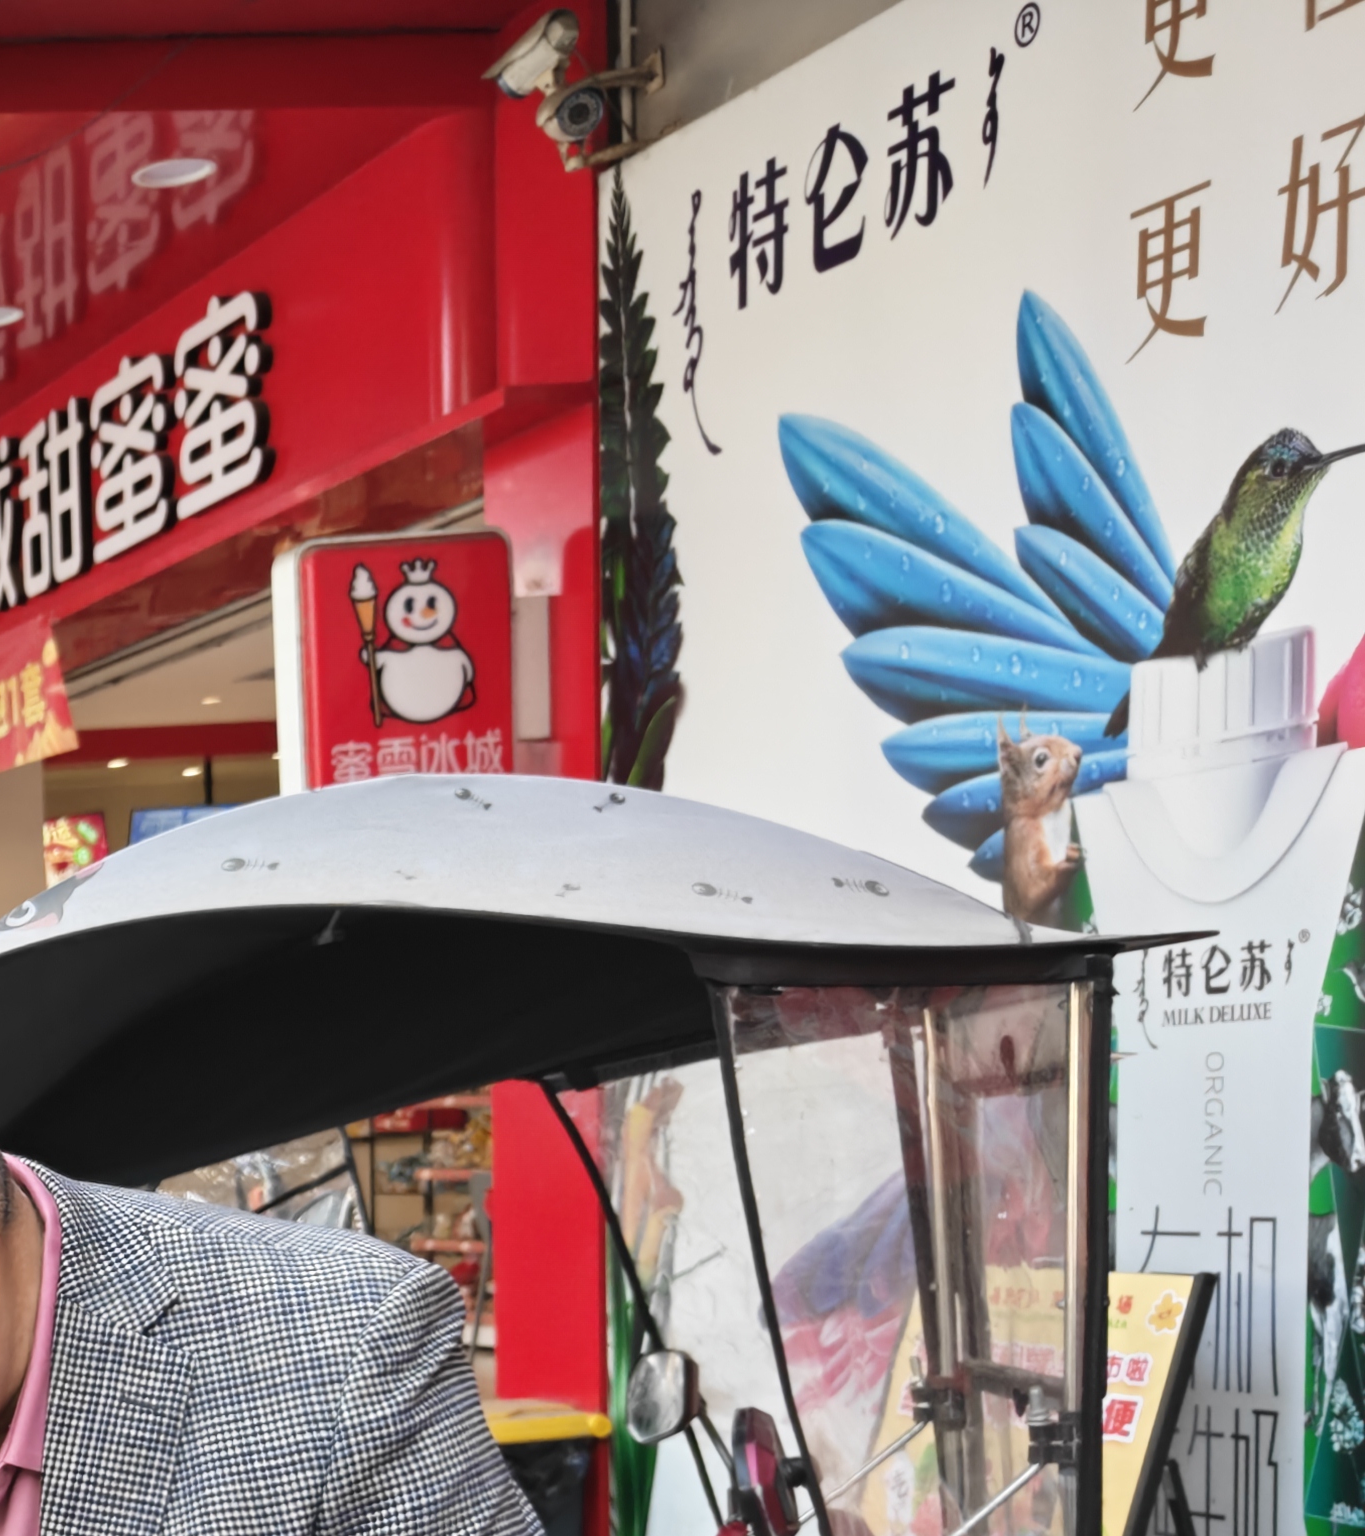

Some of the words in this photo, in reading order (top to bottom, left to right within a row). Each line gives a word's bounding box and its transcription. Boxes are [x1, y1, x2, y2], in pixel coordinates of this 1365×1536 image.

[729, 70, 956, 310] 特仑苏
[1124, 115, 1365, 365] 更好
[331, 729, 505, 783] 蜜雪冰城
[1162, 1006, 1206, 1027] MILK
[1209, 1002, 1272, 1023] DELUXE
[1163, 938, 1272, 999] 特仑苏
[1203, 1051, 1225, 1196] ORGANIC
